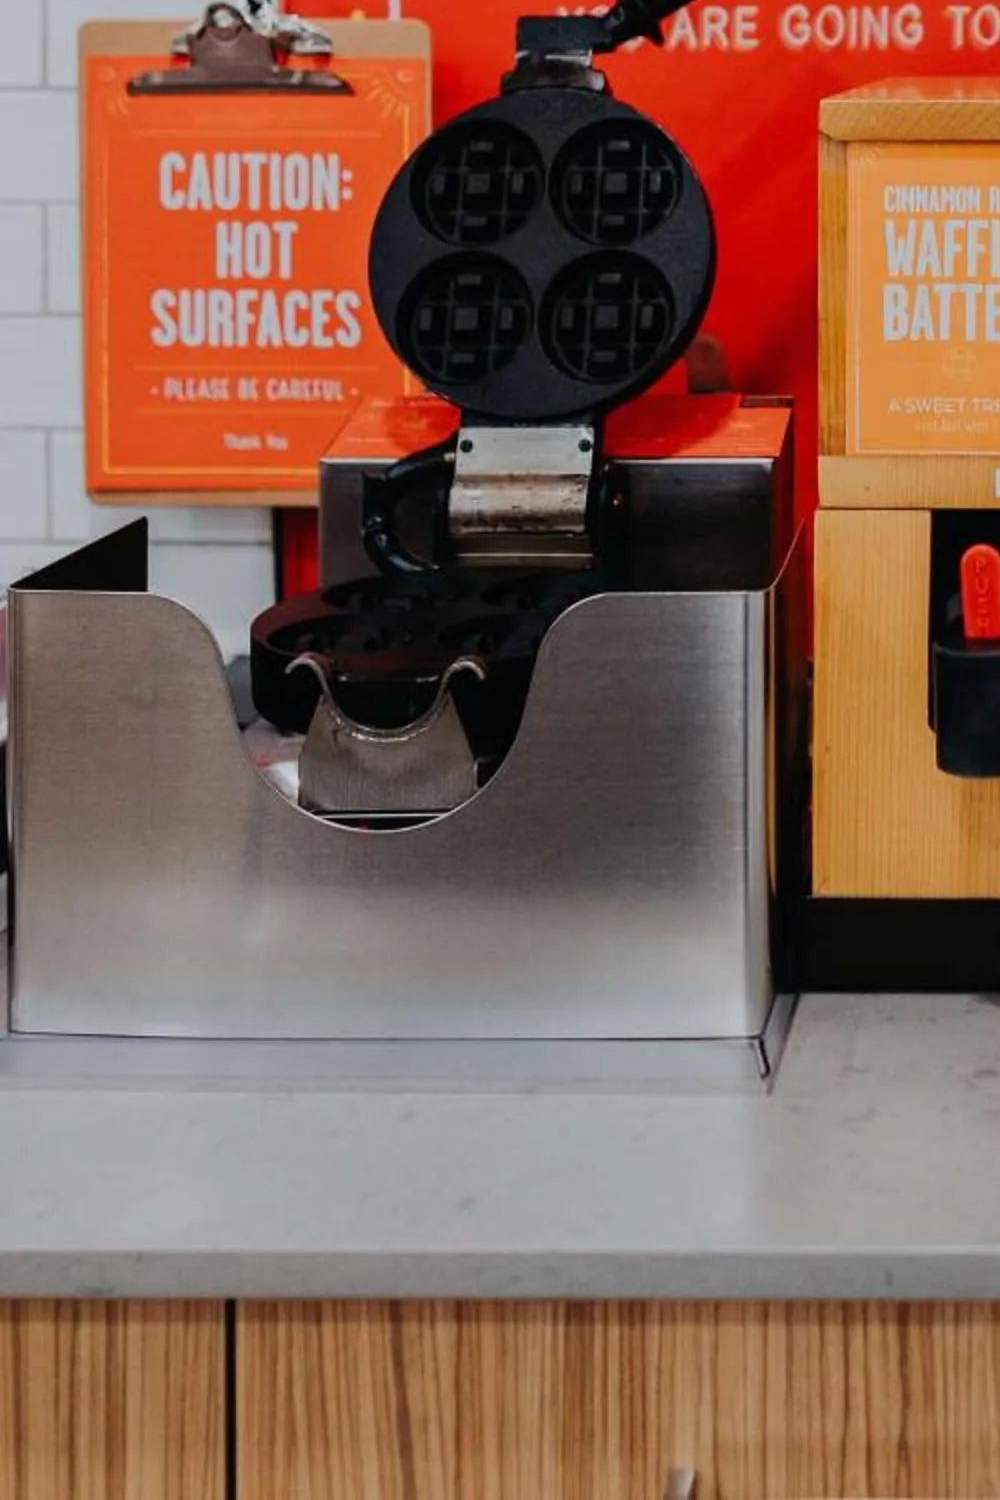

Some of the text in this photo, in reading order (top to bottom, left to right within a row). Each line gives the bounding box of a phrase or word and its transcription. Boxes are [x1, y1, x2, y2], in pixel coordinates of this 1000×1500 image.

[664, 3, 760, 53] ARE
[779, 2, 924, 51] GOING
[945, 3, 1000, 51] TO
[159, 151, 353, 212] CAUTION:
[884, 185, 980, 213] CINNAMON
[215, 220, 298, 280] HOT
[150, 289, 362, 349] SURFACES
[164, 377, 343, 402] PLEASE BE CAREFUL
[888, 397, 899, 413] A
[905, 396, 966, 414] SWEET
